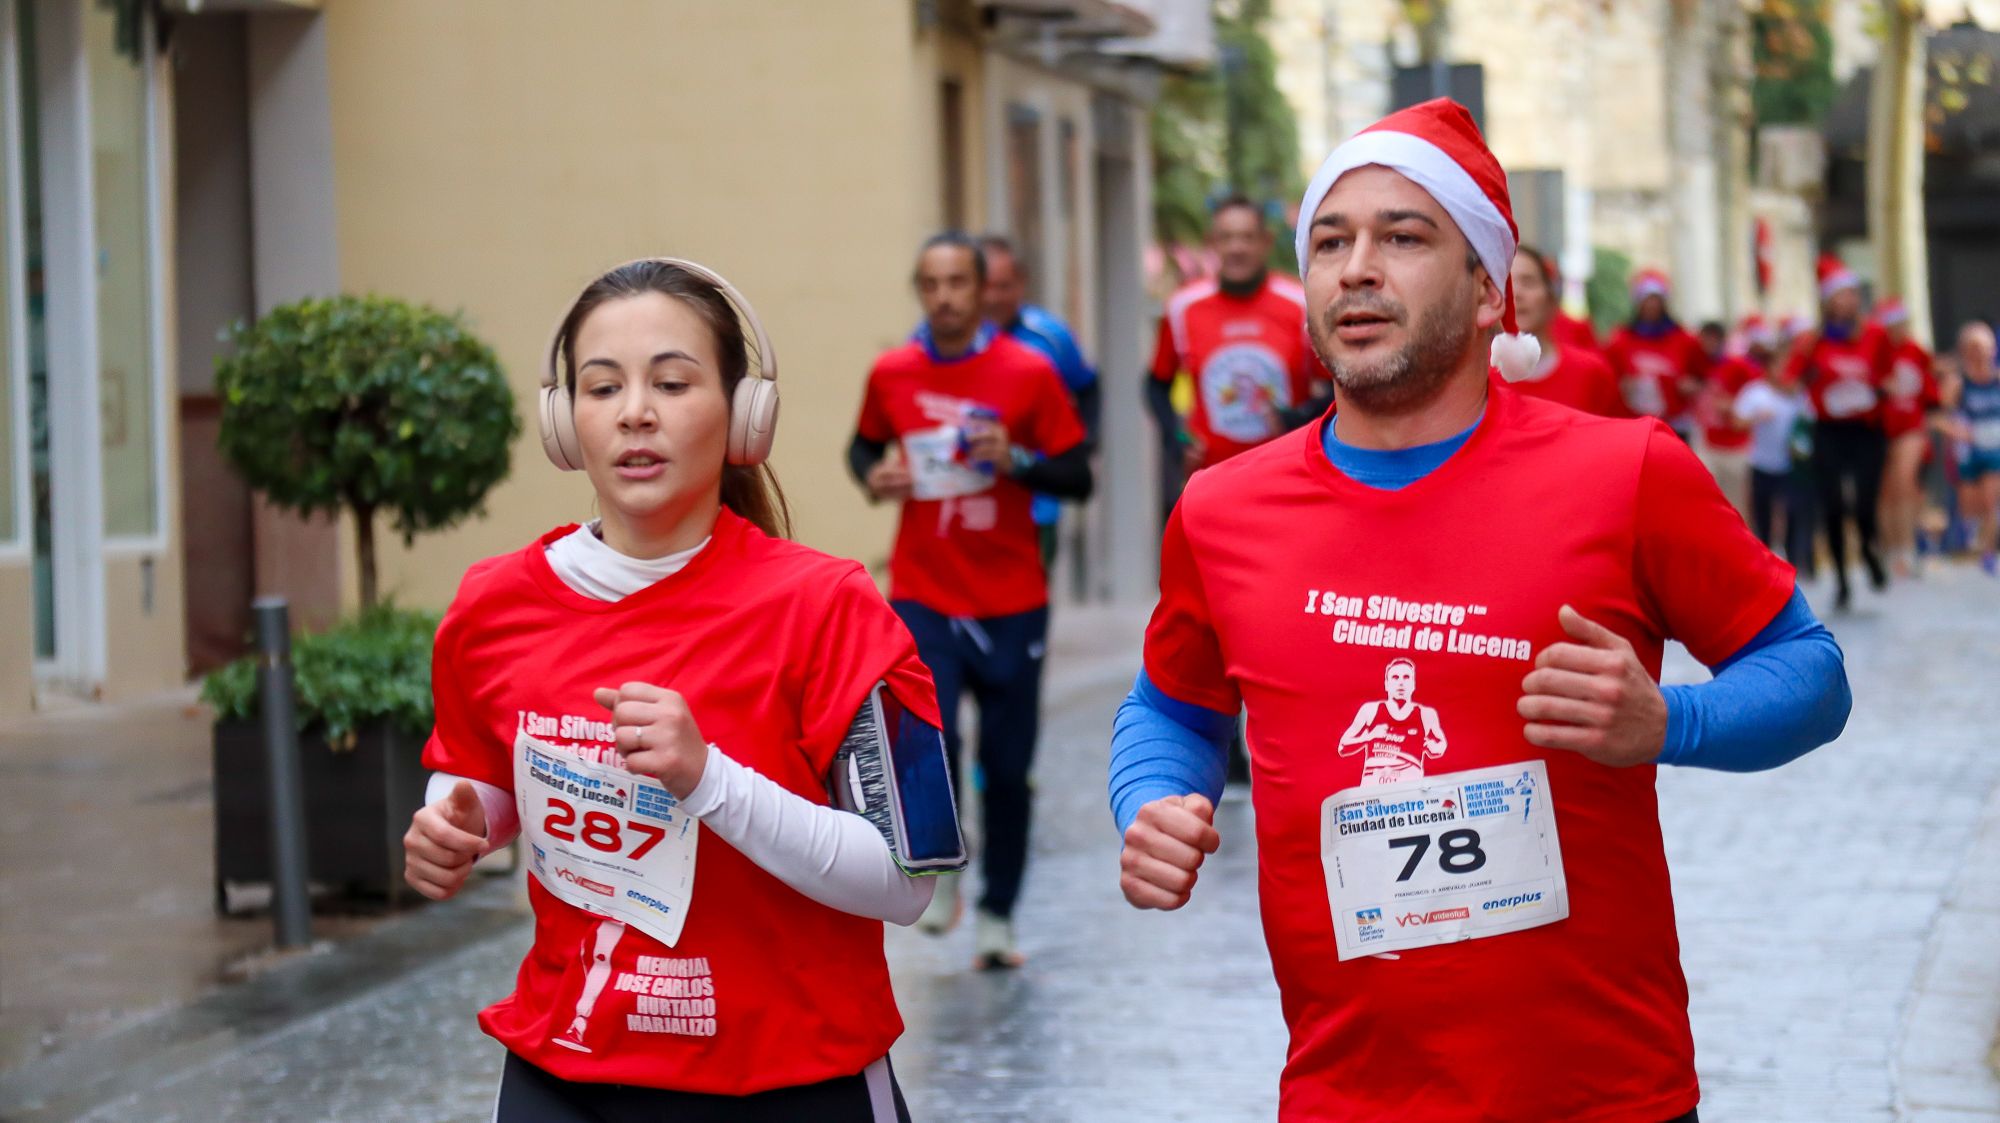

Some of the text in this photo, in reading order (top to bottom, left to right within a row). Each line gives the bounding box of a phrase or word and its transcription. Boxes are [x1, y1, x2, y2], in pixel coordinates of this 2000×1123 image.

[1305, 589, 1319, 613] I
[1320, 591, 1364, 618] San
[1366, 595, 1466, 626] Silvestre
[1332, 619, 1532, 661] Ciudad de Lucena
[526, 711, 559, 737] San
[559, 714, 616, 743] Silves
[530, 754, 549, 772] San
[551, 762, 602, 789] Silvestre
[530, 766, 625, 809] Ciudad de Lucena
[1464, 780, 1505, 793] MEMORIAL
[1485, 786, 1516, 799] CARLOS
[1339, 808, 1364, 822] San
[1365, 799, 1426, 818] Silvestre
[1467, 797, 1504, 810] HURTADO
[1468, 804, 1511, 818] MARJALIZO
[544, 797, 667, 862] 287
[1339, 810, 1456, 836] Ciudad de Lucena
[1387, 828, 1488, 883] 78
[627, 889, 670, 914] enerplus
[1482, 891, 1543, 911] enerplus
[636, 955, 713, 978] MEMORIAL
[613, 972, 715, 998] JOSE CARLOS
[636, 994, 717, 1017] HURTADO
[626, 1013, 718, 1038] MARJALIZO
